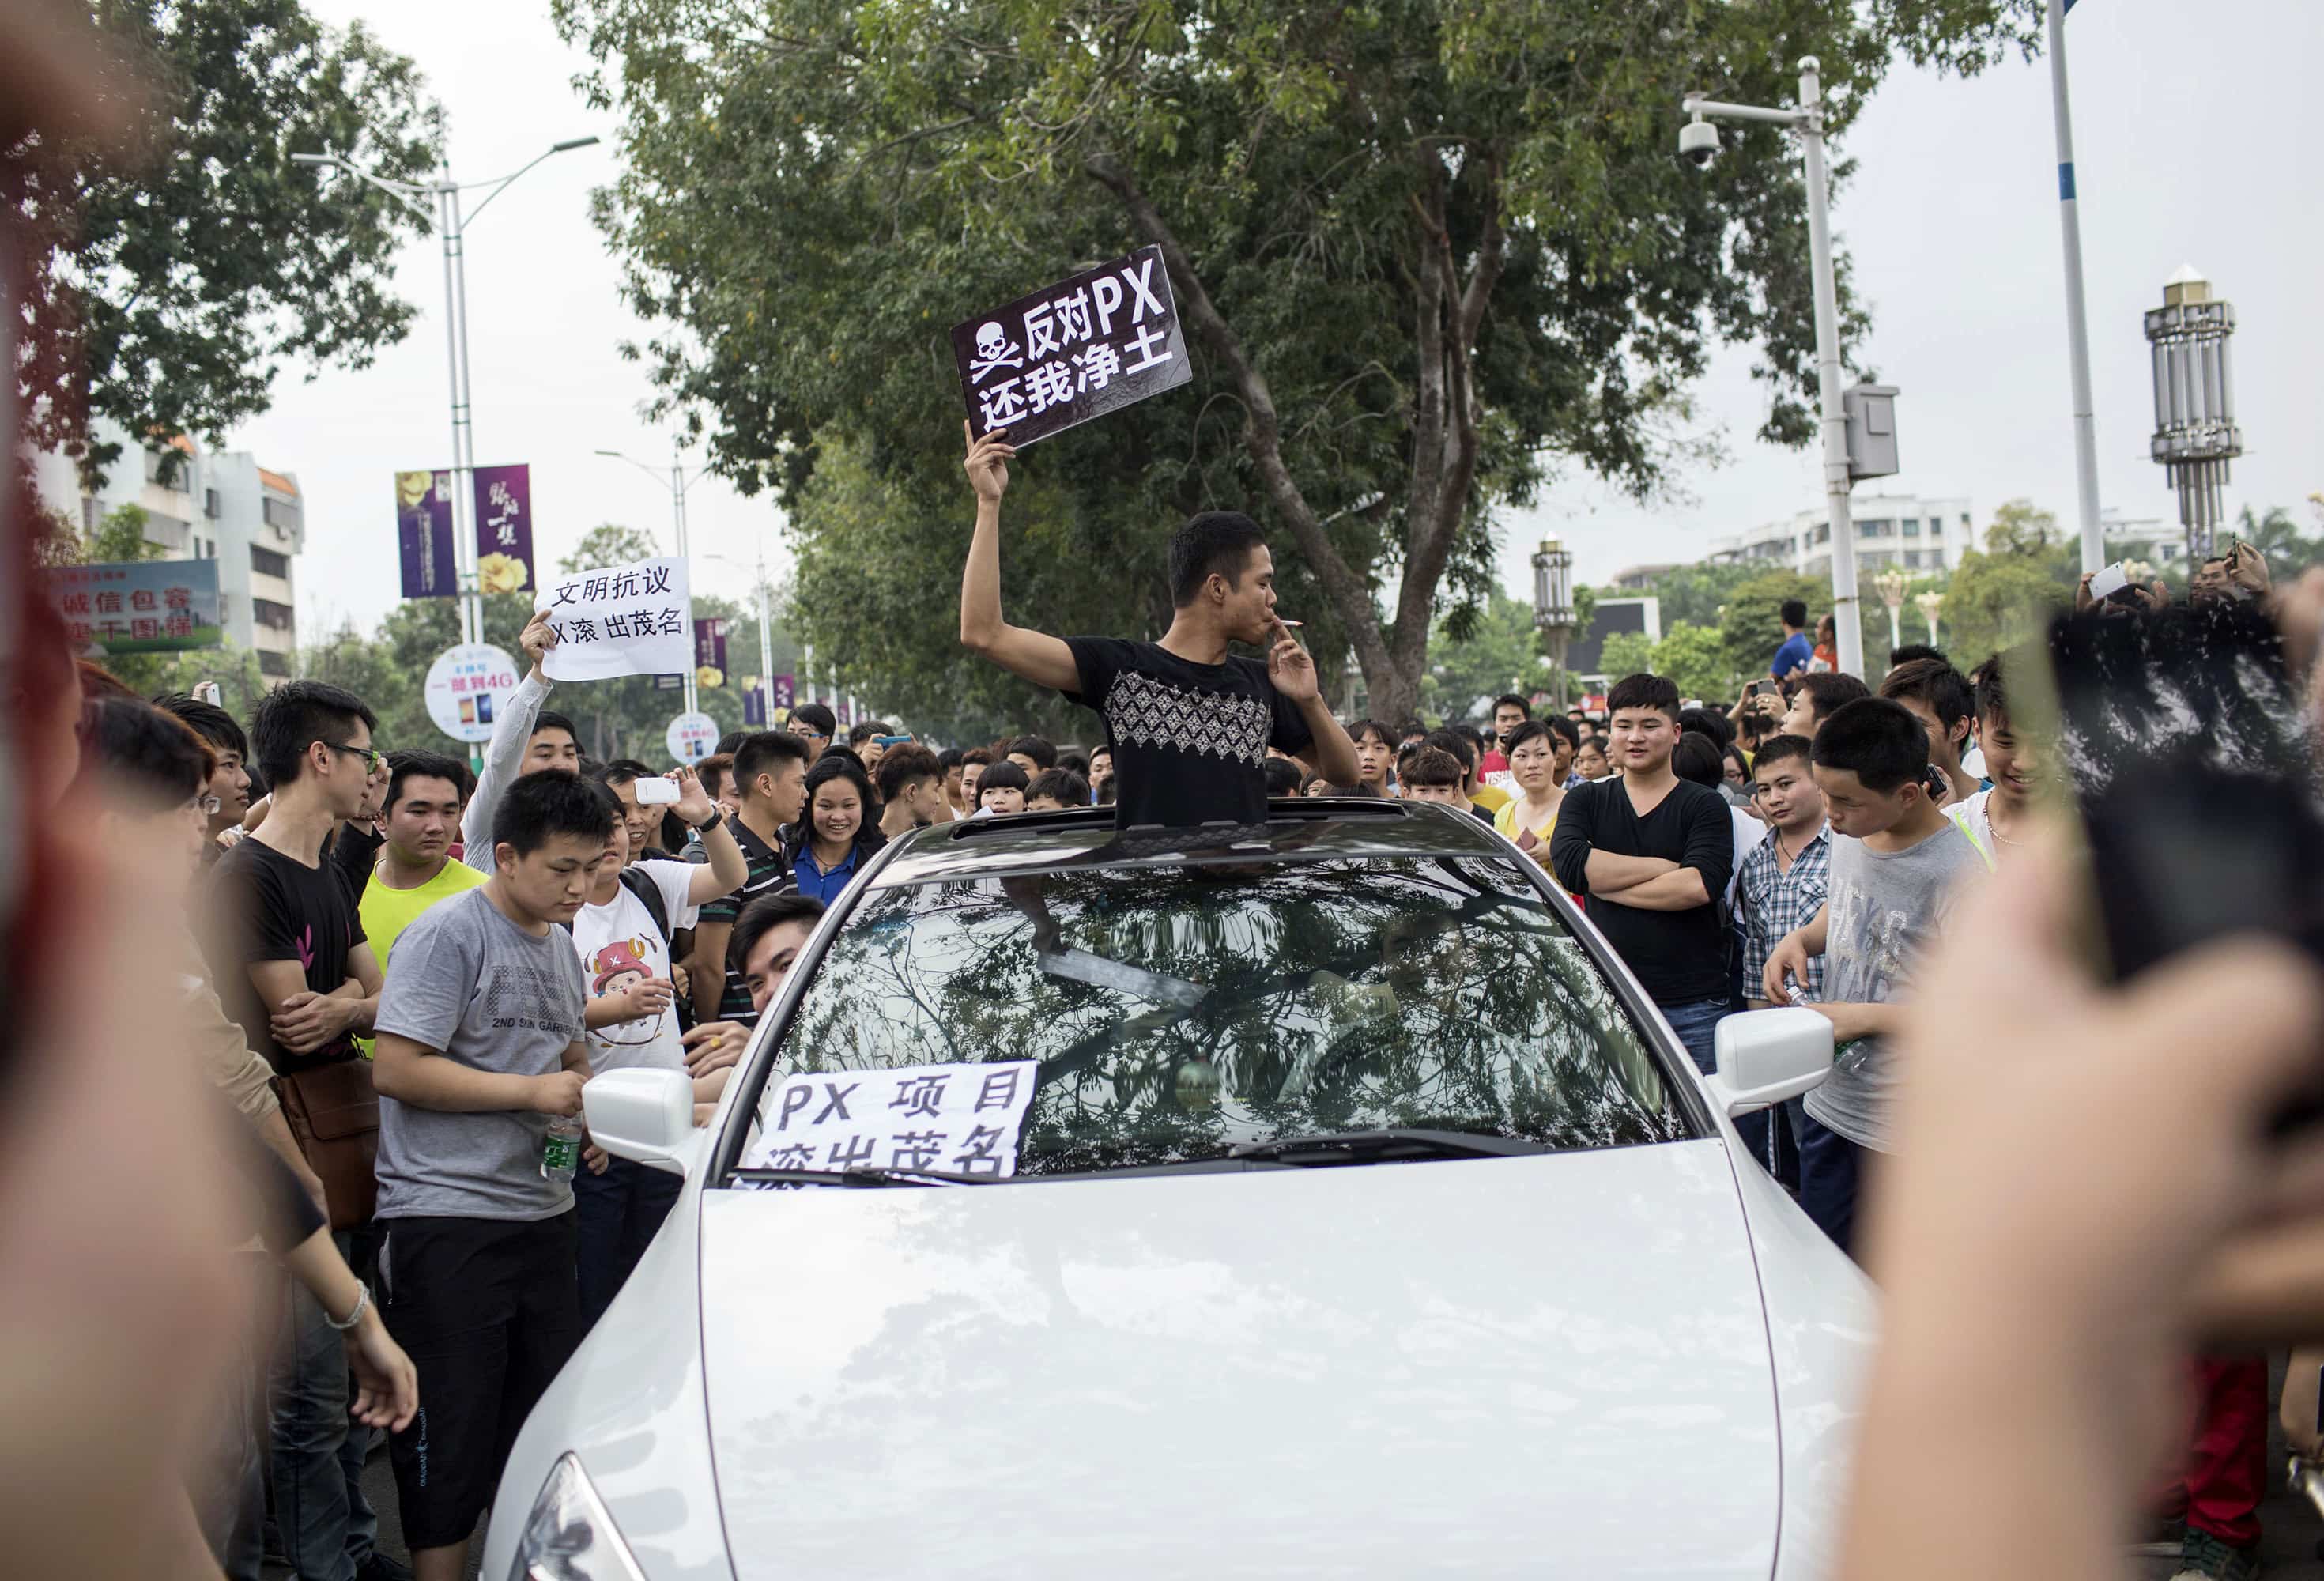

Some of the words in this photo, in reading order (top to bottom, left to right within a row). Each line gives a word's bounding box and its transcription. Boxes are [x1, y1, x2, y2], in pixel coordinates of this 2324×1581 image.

[979, 324, 1173, 433] 还我净土
[552, 566, 671, 607] 文明抗议
[492, 1018, 515, 1028] 2ND
[778, 1081, 861, 1131] PX
